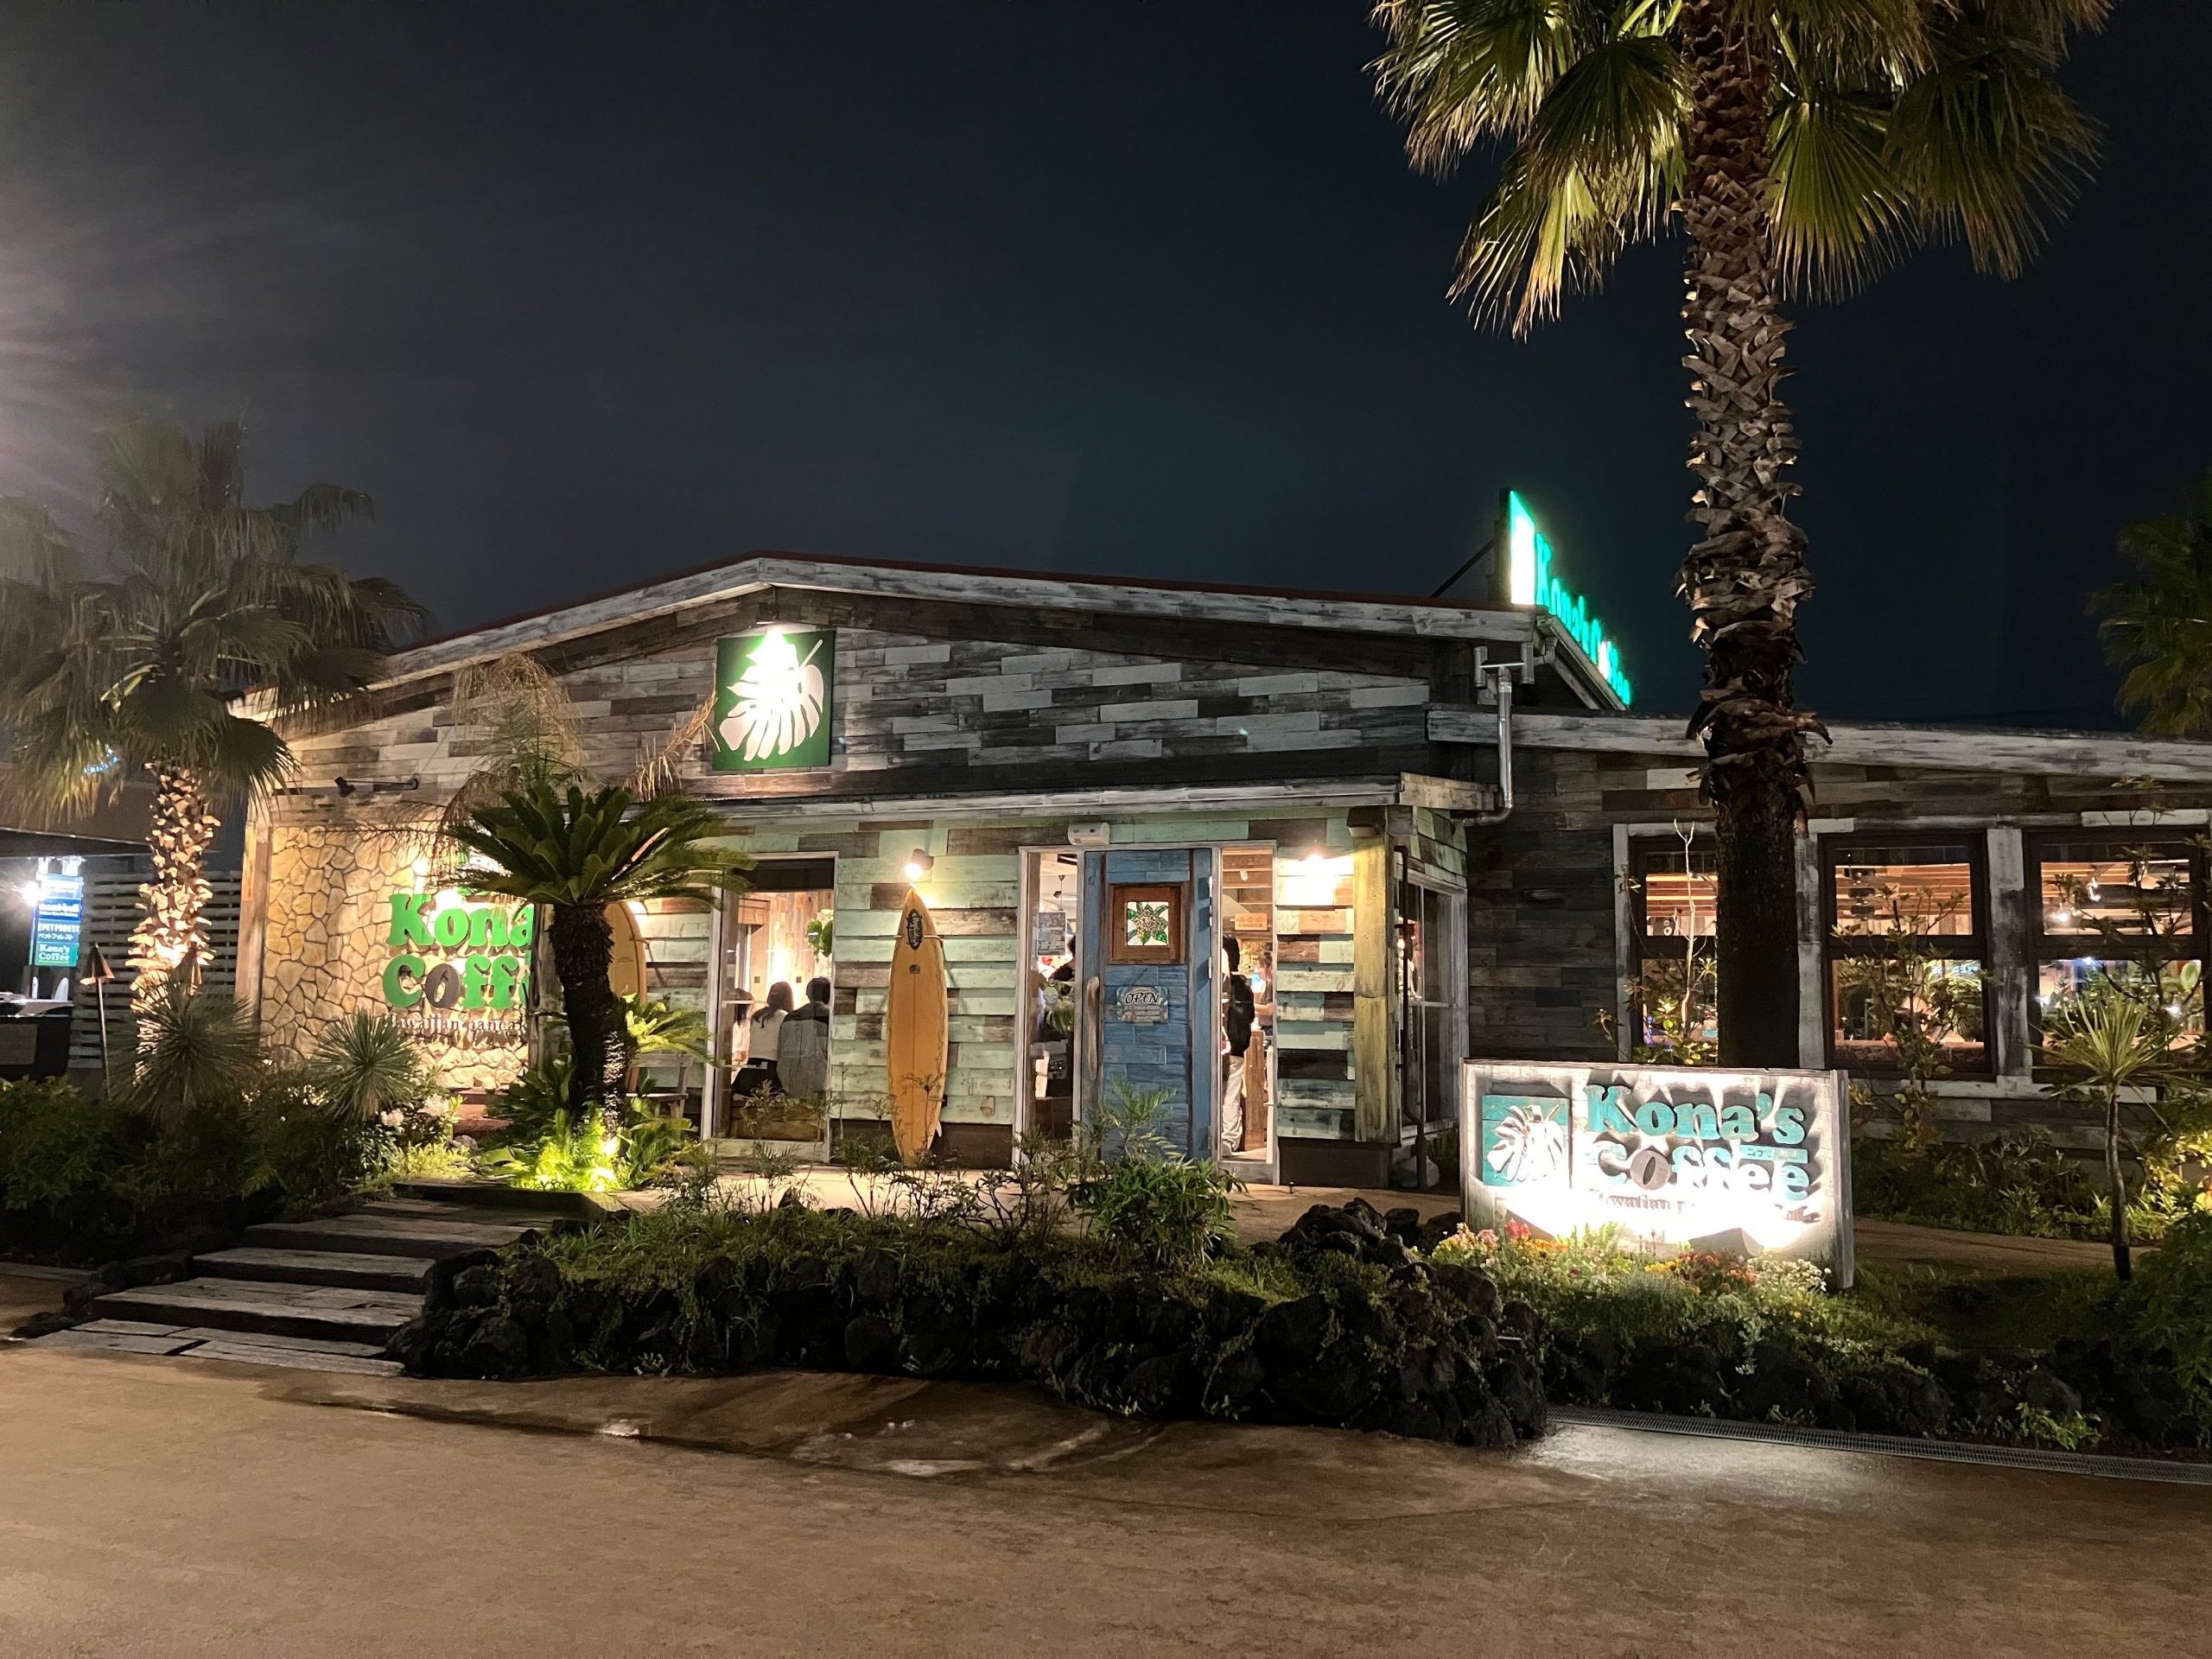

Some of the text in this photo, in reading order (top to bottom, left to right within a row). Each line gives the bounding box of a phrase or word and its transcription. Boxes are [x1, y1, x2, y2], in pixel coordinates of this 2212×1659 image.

[39, 944, 70, 953] Kona's
[38, 952, 70, 961] Coffee
[1124, 992, 1160, 1005] OPEN
[1583, 1084, 1805, 1145] Kona's
[1585, 1140, 1809, 1201] Coffee
